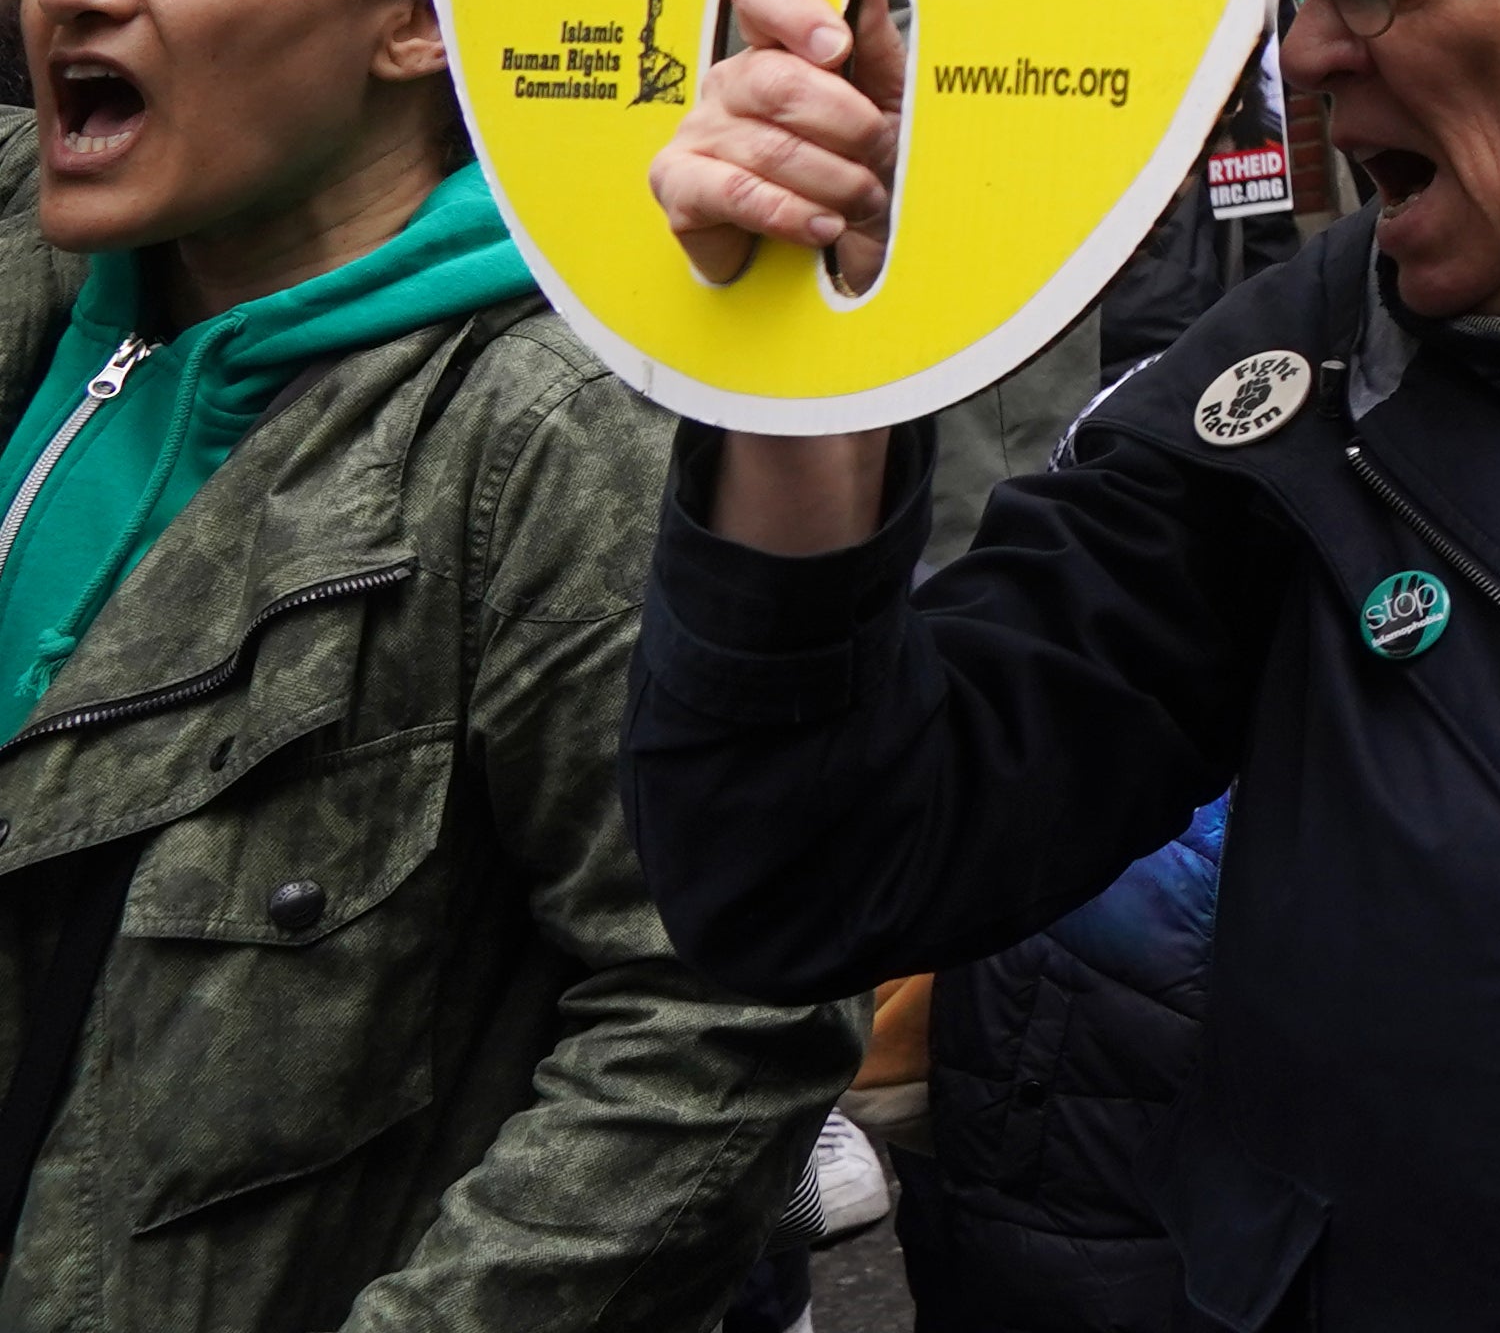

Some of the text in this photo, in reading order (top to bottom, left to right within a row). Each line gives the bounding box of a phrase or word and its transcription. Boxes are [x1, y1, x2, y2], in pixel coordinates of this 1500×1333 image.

[560, 21, 624, 44] Islamic
[501, 48, 621, 77] Human Rights
[515, 75, 618, 100] Commission
[935, 59, 1129, 107] www.ihrc.org
[1234, 356, 1300, 382] Fight
[1201, 401, 1283, 438] Racism
[1365, 583, 1438, 630] stop
